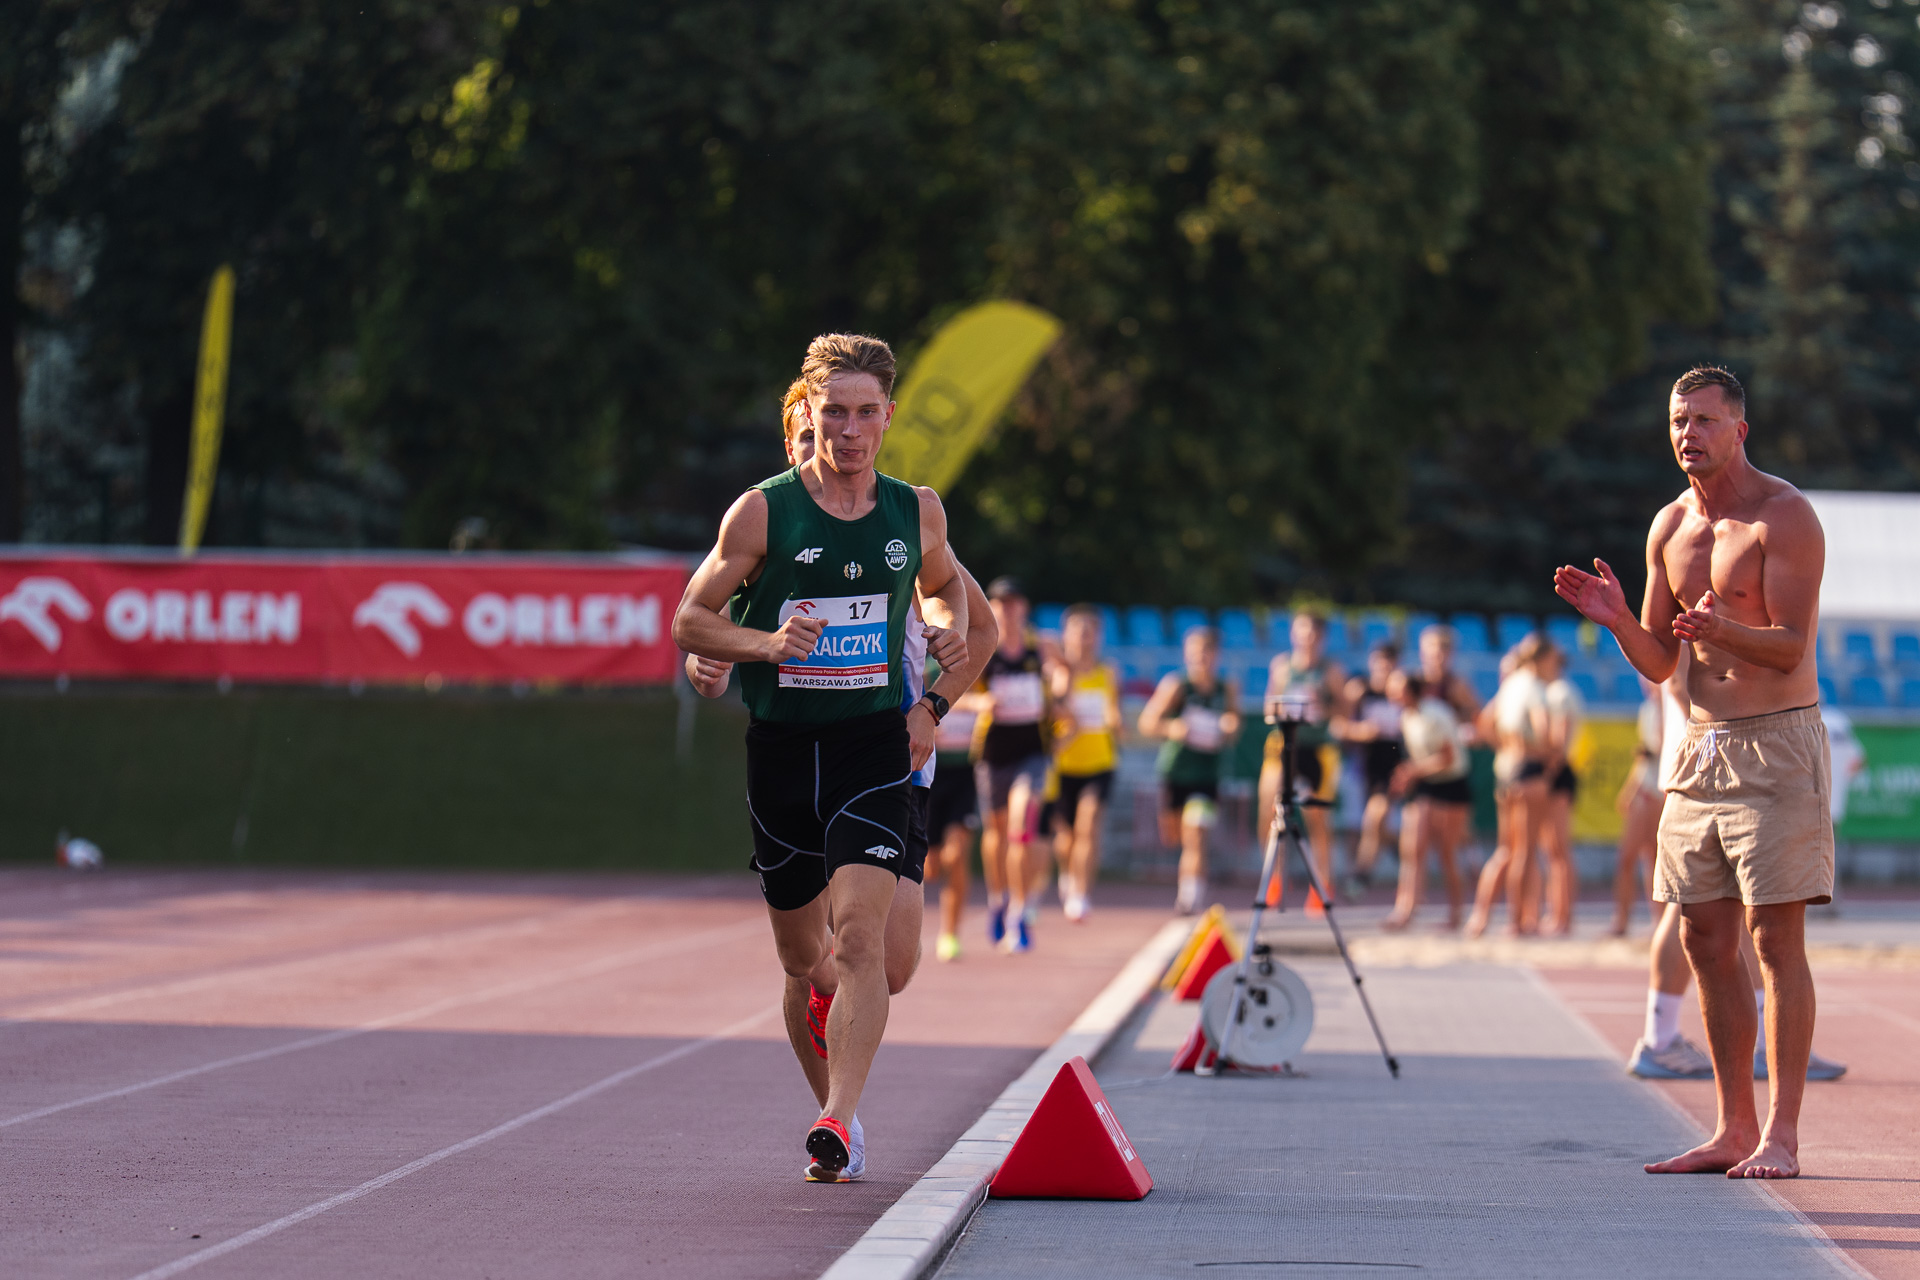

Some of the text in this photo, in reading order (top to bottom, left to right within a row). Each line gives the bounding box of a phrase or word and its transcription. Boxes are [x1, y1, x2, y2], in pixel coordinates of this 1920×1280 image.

[794, 547, 824, 564] 4F
[890, 544, 903, 552] AZS
[890, 556, 905, 564] AWF
[105, 588, 299, 643] ORLEN
[848, 601, 872, 620] 17
[463, 593, 661, 646] ORLEN
[809, 632, 883, 657] RALCZYK
[792, 676, 874, 687] WARSZAWA 2026
[864, 844, 899, 860] 4F
